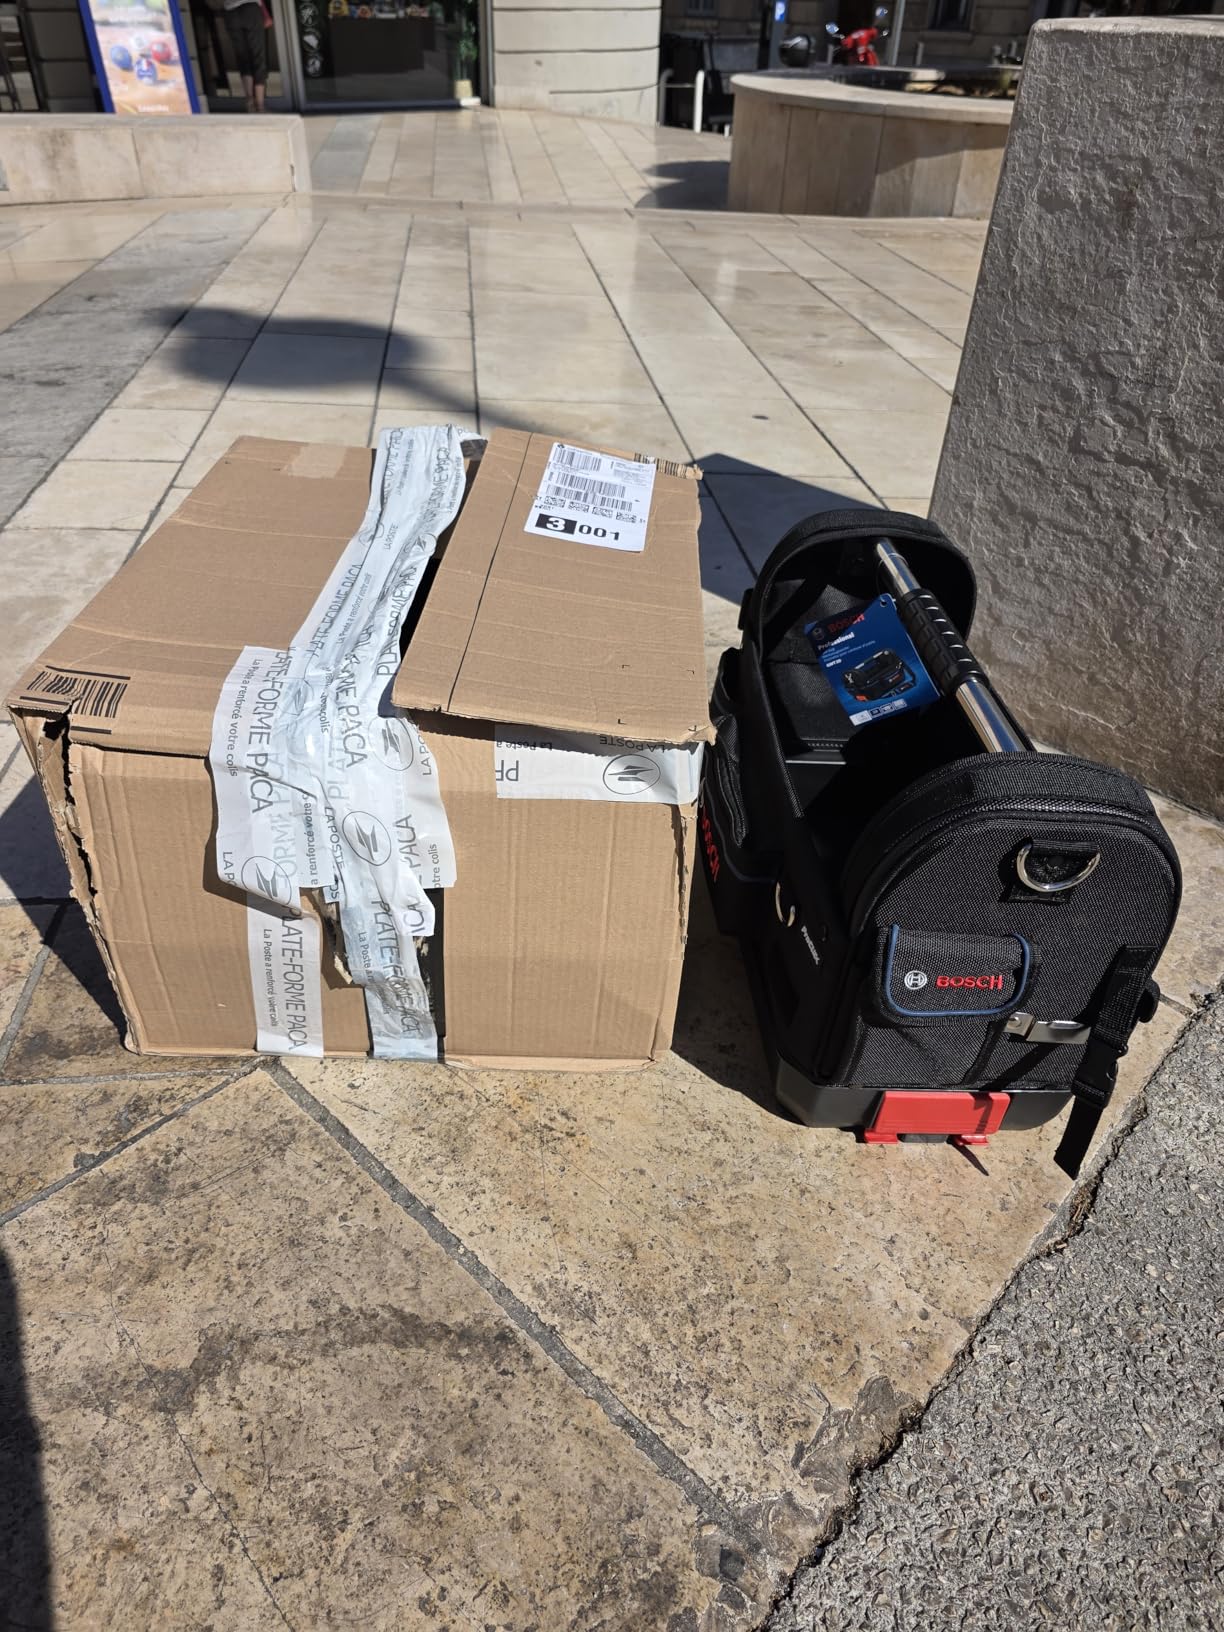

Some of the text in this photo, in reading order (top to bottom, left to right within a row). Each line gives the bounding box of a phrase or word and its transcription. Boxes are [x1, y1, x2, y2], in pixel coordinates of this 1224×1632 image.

[545, 517, 621, 541] 3 001
[231, 685, 248, 719] renforcé
[226, 721, 239, 751] votre
[338, 704, 368, 768] PACA
[600, 736, 644, 751] POSTE
[226, 753, 239, 777] colis
[422, 757, 433, 776] LA
[246, 752, 274, 813] PACA
[303, 802, 313, 830] votre
[324, 806, 336, 824] LA
[222, 851, 234, 871] LA
[304, 831, 319, 876] renforcé
[429, 843, 440, 865] colis
[263, 928, 273, 939] La
[358, 931, 368, 942] La
[263, 940, 273, 961] Poste
[362, 943, 372, 969] Poste
[265, 967, 276, 996] renforcé
[936, 975, 1003, 990] BOSCH
[285, 1014, 308, 1051] PACA
